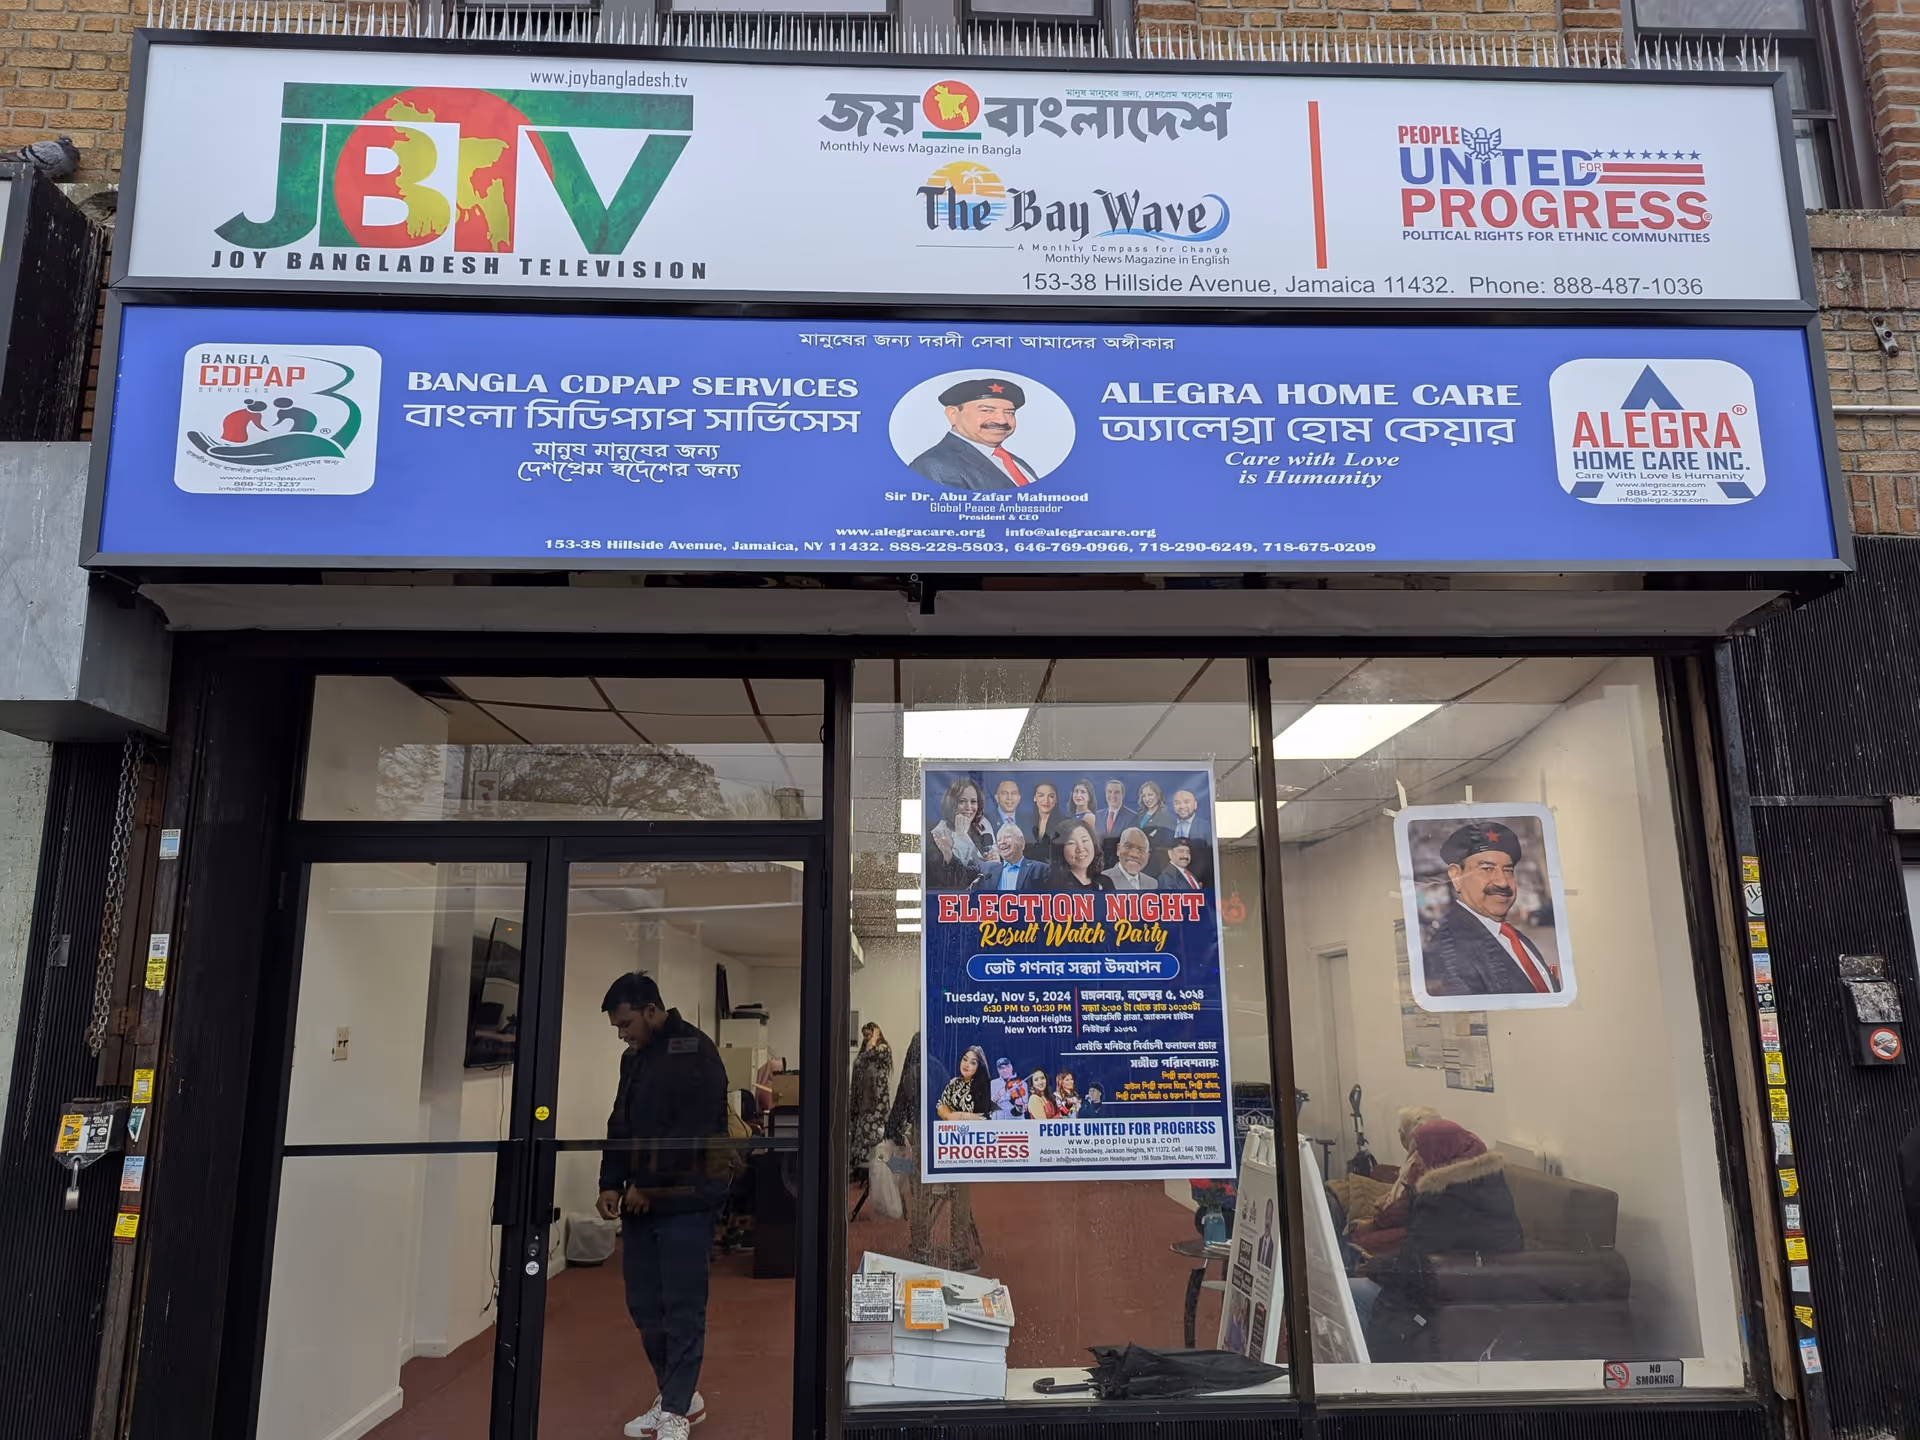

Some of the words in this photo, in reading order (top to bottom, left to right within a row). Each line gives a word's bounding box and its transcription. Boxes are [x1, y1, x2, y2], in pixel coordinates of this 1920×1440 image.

[530, 69, 688, 90] www.joybangladesh.tv
[1066, 89, 1087, 98] মানুষ
[1089, 90, 1119, 99] মানুষের
[1122, 91, 1141, 99] জন্য,
[1145, 91, 1177, 99] দেশপ্রেম
[1216, 92, 1232, 100] জন্য
[984, 97, 1232, 143] বাংলাদেশ
[1398, 126, 1460, 145] PEOPLE
[820, 140, 869, 154] Monthly
[872, 142, 905, 154] News
[908, 143, 965, 156] Magazine
[968, 144, 978, 154] in
[982, 144, 1021, 157] Bangla
[1400, 146, 1597, 187] UNITED
[1579, 162, 1602, 173] FOR
[916, 186, 992, 231] The
[1005, 188, 1089, 242] Bay
[1093, 188, 1207, 233] Wave
[1401, 188, 1711, 230] PROGRESS
[1402, 230, 1471, 241] POLITICAL
[1474, 230, 1523, 241] RIGHTS
[1528, 231, 1553, 242] FOR
[1559, 232, 1608, 242] ETHNIC
[1612, 232, 1710, 243] COMMUNITIES
[1032, 244, 1083, 253] Monthly
[1091, 244, 1148, 254] Compass
[1155, 245, 1174, 253] for
[1181, 245, 1228, 255] Change
[211, 250, 268, 270] JOY
[287, 252, 501, 275] BANGLADESH
[519, 258, 707, 280] TELEVISION
[1045, 253, 1095, 265] Monthly
[1098, 254, 1121, 264] News
[1124, 254, 1176, 266] Magazine
[1179, 254, 1188, 264] in
[1191, 254, 1230, 266] English
[1022, 272, 1097, 291] 153-38
[1104, 272, 1185, 292] Hillside
[1190, 274, 1276, 295] Avenue,
[1285, 274, 1376, 294] Jamaica
[1383, 276, 1455, 294] 11432.
[1470, 276, 1545, 295] Phone:
[1553, 277, 1703, 295] 888-487-1036
[799, 332, 865, 350] মানুষের
[874, 334, 912, 348] জন্য
[918, 332, 963, 348] দরদী
[971, 336, 1013, 349] সেবা
[1020, 336, 1096, 350] আমাদের
[1103, 333, 1175, 351] অঙ্গীকার
[201, 354, 270, 365] BANGLA
[200, 365, 306, 387] CDPAP
[408, 372, 548, 393] BANGLA
[560, 374, 680, 395] CDPAP
[692, 377, 859, 398] SERVICES
[1101, 382, 1262, 404] ALEGRA
[1278, 384, 1399, 405] HOME
[1412, 384, 1521, 406] CARE
[403, 404, 517, 430] বাংলা
[525, 398, 695, 431] সিডিপ্যাপ
[704, 401, 861, 434] সার্ভিসেস
[1099, 416, 1275, 445] অ্যালেগ্রা
[1287, 418, 1373, 444] হোম
[1385, 418, 1516, 446] কেয়ার
[1572, 412, 1741, 449] ALEGRA
[532, 441, 587, 462] মানুষ
[594, 442, 668, 463] মানুষের
[677, 444, 720, 461] জন্য
[1225, 450, 1280, 466] Care
[1288, 452, 1336, 466] with
[1345, 453, 1400, 467] Love
[1573, 452, 1635, 470] HOME
[1642, 452, 1700, 470] CARE
[1706, 452, 1750, 470] INC.
[518, 461, 602, 482] দেশপ্রেম
[611, 462, 690, 483] স্বদেশের
[697, 463, 740, 480] জন্য
[1239, 470, 1257, 485] is
[1265, 470, 1382, 488] Humanity
[1684, 472, 1744, 481] Humanity
[884, 492, 906, 501] Sir
[912, 492, 934, 501] Dr.
[939, 492, 967, 502] Abu
[972, 492, 1012, 502] Zafar
[1017, 493, 1088, 502] Mahmood
[1617, 496, 1708, 504] info@alegracare.com
[930, 503, 961, 513] Global
[965, 504, 995, 513] Peace
[999, 504, 1063, 513] Ambassador
[836, 528, 985, 538] www.alegracare.org
[1006, 528, 1156, 538] info@alegracare.org
[545, 540, 601, 550] 153-38
[606, 540, 664, 550] Hillside
[668, 542, 727, 552] Avenue,
[732, 541, 799, 552] Jamaica,
[804, 542, 823, 552] NY
[828, 542, 884, 552] 11432.
[889, 542, 1009, 553] 888-228-5803,
[1014, 542, 1133, 554] 646-769-0966,
[1139, 542, 1257, 554] 718-290-6249,
[1263, 542, 1376, 553] 718-675-0209
[938, 894, 1095, 923] ELECTION
[1106, 893, 1205, 922] NIGHT
[979, 920, 1039, 947] Result
[1044, 915, 1105, 946] Watch
[1114, 919, 1168, 951] Party
[984, 958, 1015, 976] ভোট
[1020, 961, 1064, 976] গণনার
[1068, 960, 1101, 975] সন্ধ্যা
[1106, 958, 1161, 974] উদযাপন
[944, 992, 998, 1004] Tuesday,
[1002, 992, 1025, 1001] Nov
[1028, 992, 1039, 1002] 5,
[1042, 992, 1071, 1001] 2024
[1180, 990, 1204, 1000] ২০২৪
[984, 1004, 1002, 1012] 6:30
[1004, 1004, 1018, 1012] PM
[1020, 1004, 1030, 1012] to
[1032, 1004, 1055, 1012] 10:30
[1058, 1004, 1071, 1012] PM
[944, 1016, 980, 1025] Diversity
[982, 1016, 1006, 1024] Plaza,
[1008, 1015, 1039, 1023] Jackson
[1041, 1015, 1072, 1024] Heights
[1005, 1026, 1024, 1034] New
[1026, 1026, 1047, 1034] York
[1040, 1124, 1080, 1137] PEOPLE
[1084, 1122, 1125, 1136] UNITED
[1129, 1122, 1151, 1135] FOR
[1154, 1121, 1216, 1135] PROGRESS
[938, 1132, 997, 1145] UNITED
[1068, 1137, 1180, 1146] www.peopleupusa.com
[938, 1145, 1030, 1160] PROGRESS
[1650, 1364, 1661, 1373] NO
[1636, 1374, 1674, 1385] SMOKING
